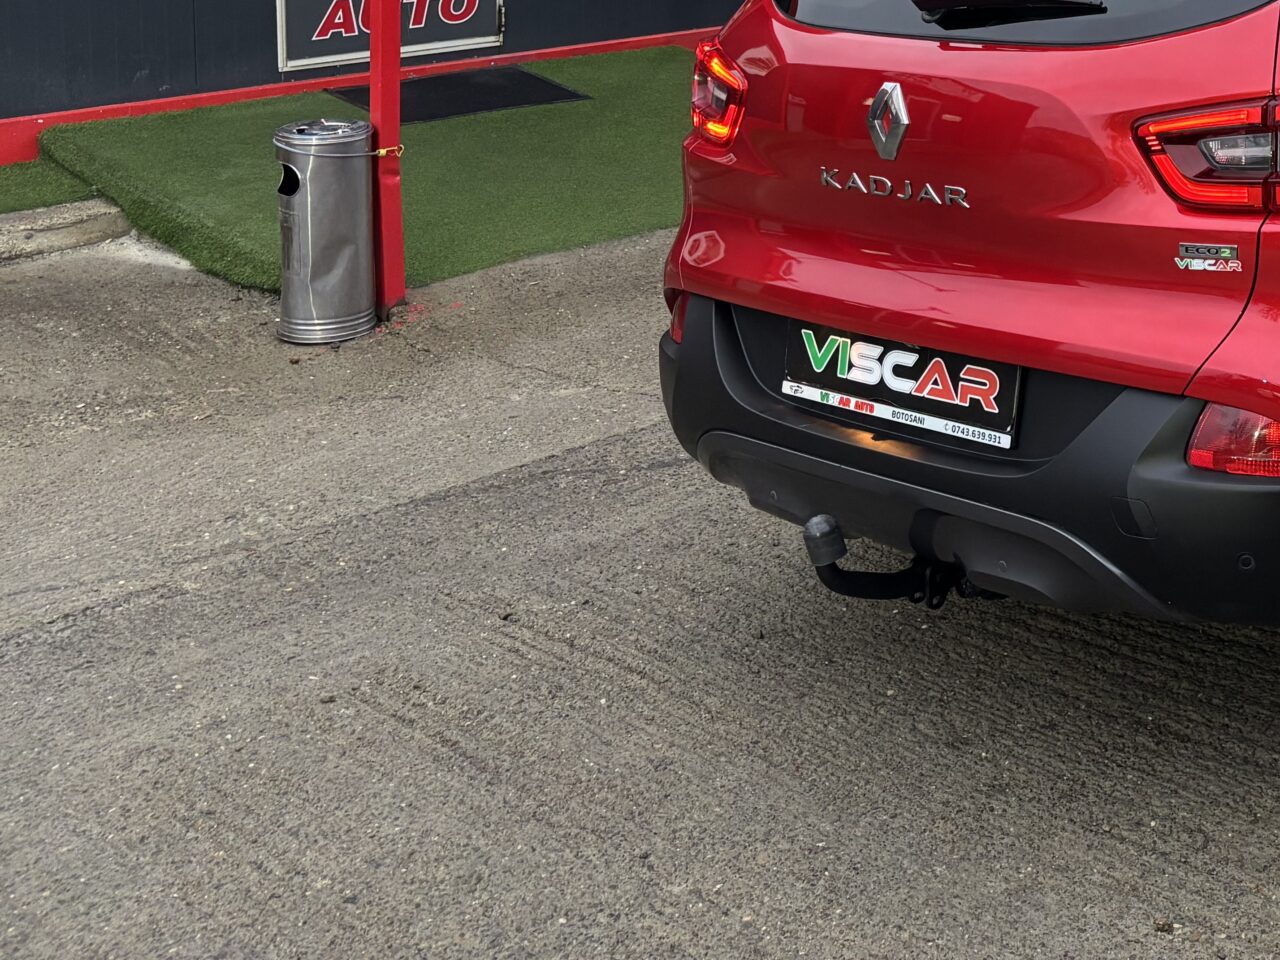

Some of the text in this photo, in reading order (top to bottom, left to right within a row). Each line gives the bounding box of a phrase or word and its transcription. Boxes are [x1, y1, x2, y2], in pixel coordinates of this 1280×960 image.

[820, 166, 971, 209] KADJAR
[1174, 257, 1242, 272] VISCAR
[1184, 246, 1232, 257] ECO2
[801, 328, 1000, 414] VISCAR
[820, 390, 1003, 445] VISCAR AUTO BOTOSANI 0743.639.931
